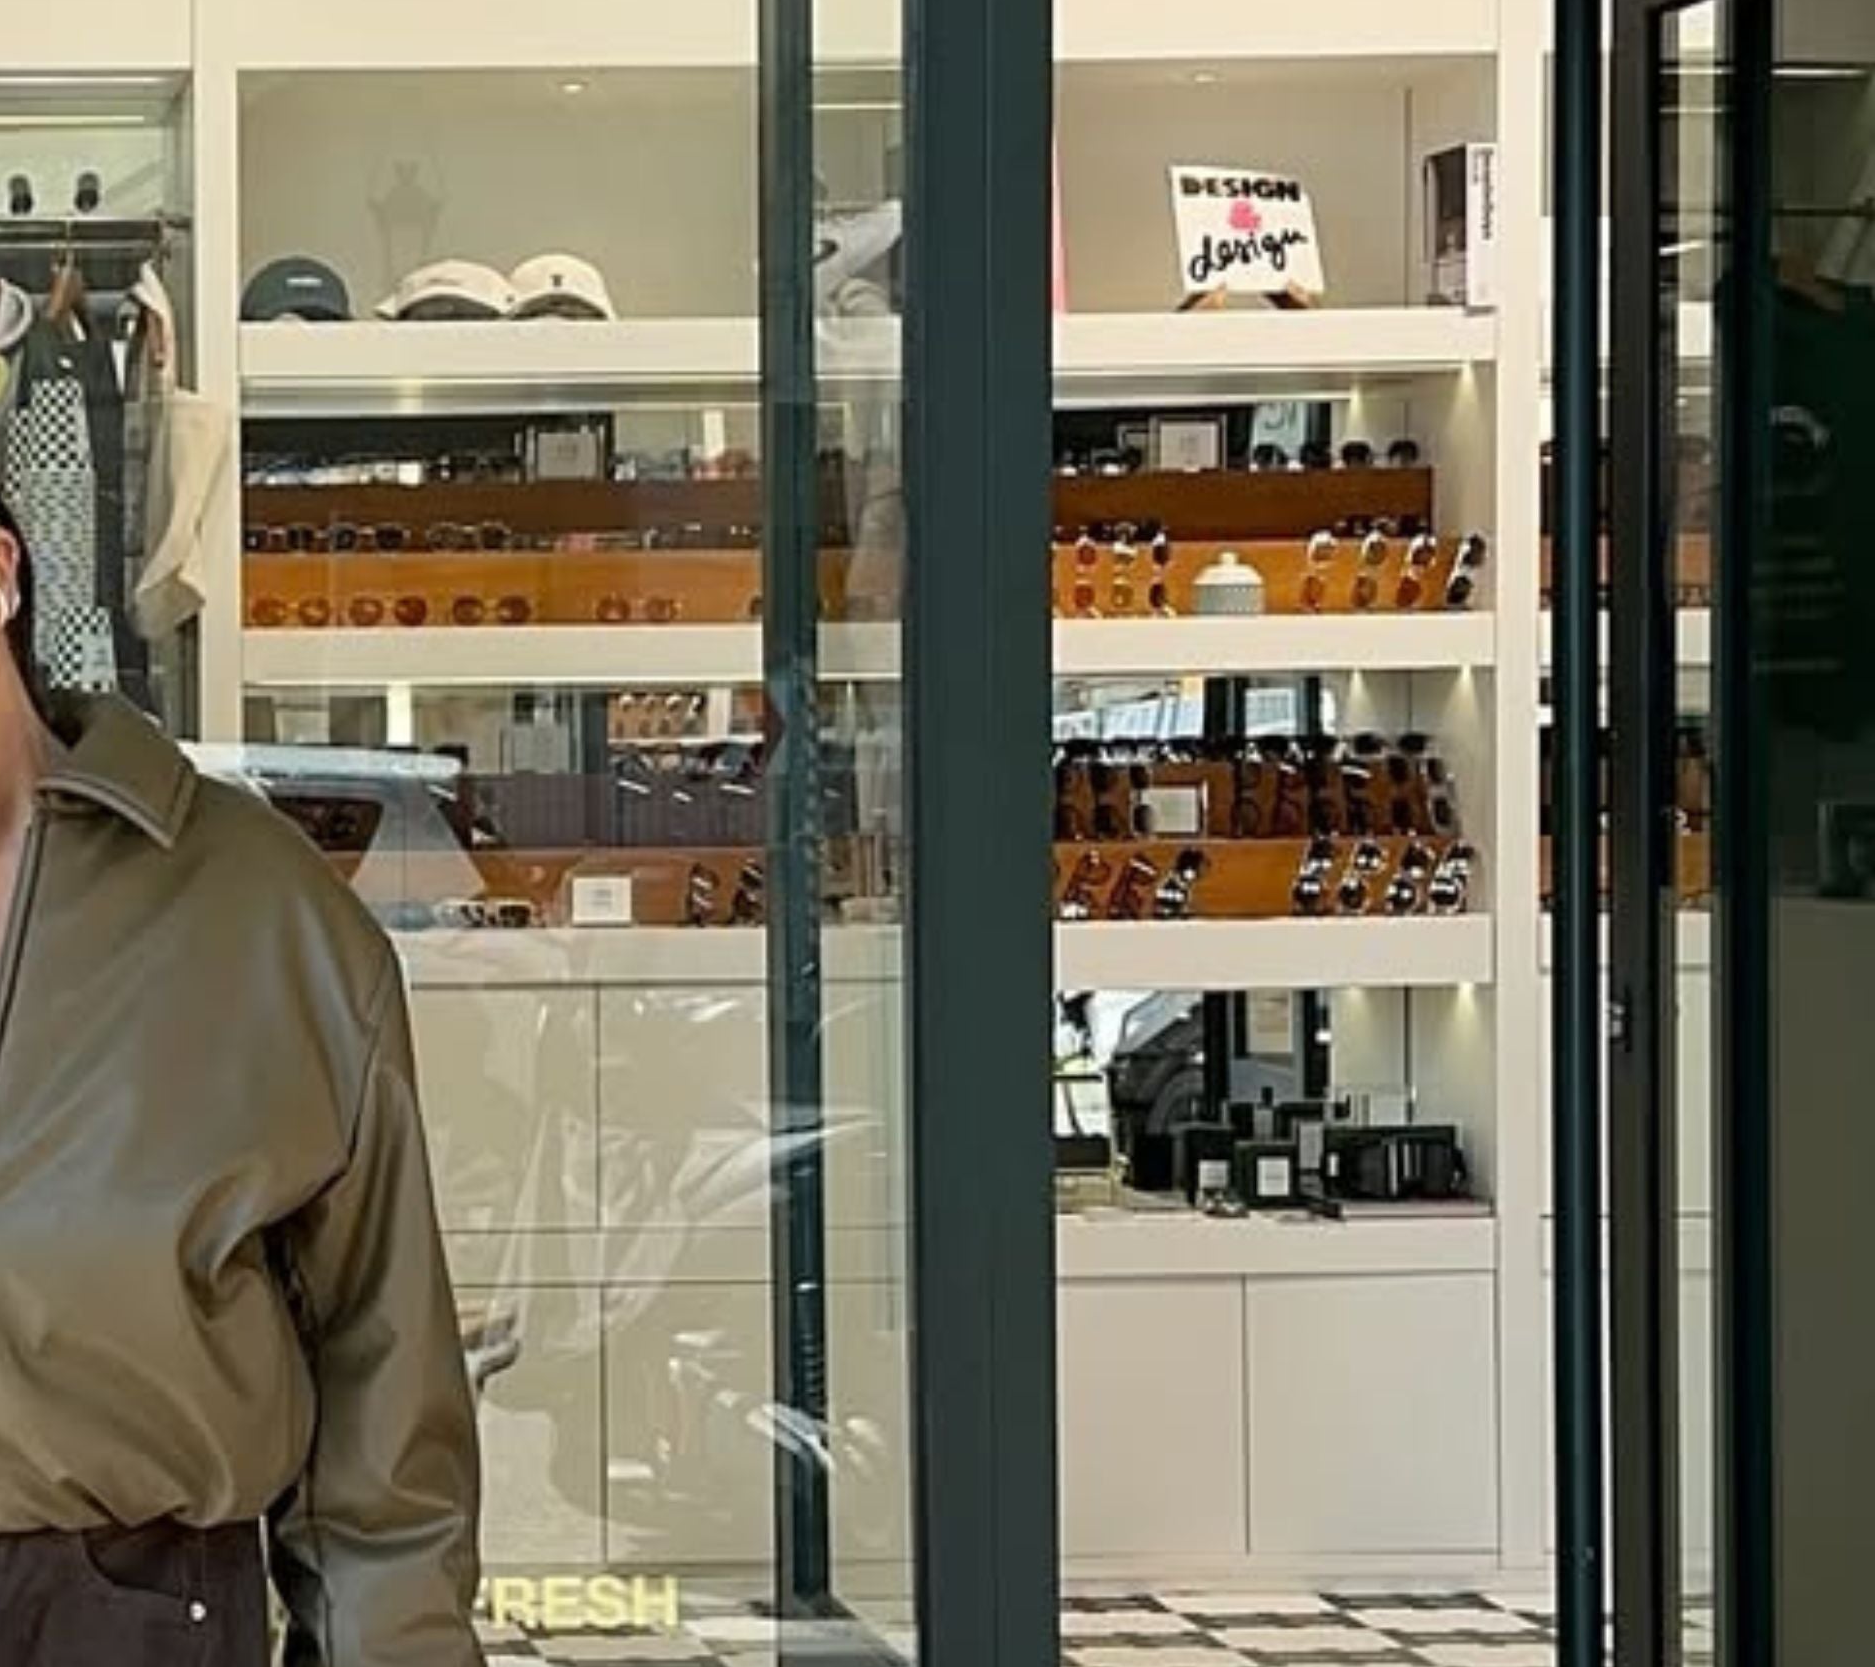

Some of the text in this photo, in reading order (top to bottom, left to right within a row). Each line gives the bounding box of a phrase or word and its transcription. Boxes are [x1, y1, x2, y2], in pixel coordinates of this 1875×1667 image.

[1180, 175, 1301, 202] DESIGN
[1189, 231, 1308, 283] design
[473, 1575, 680, 1629] RESH
